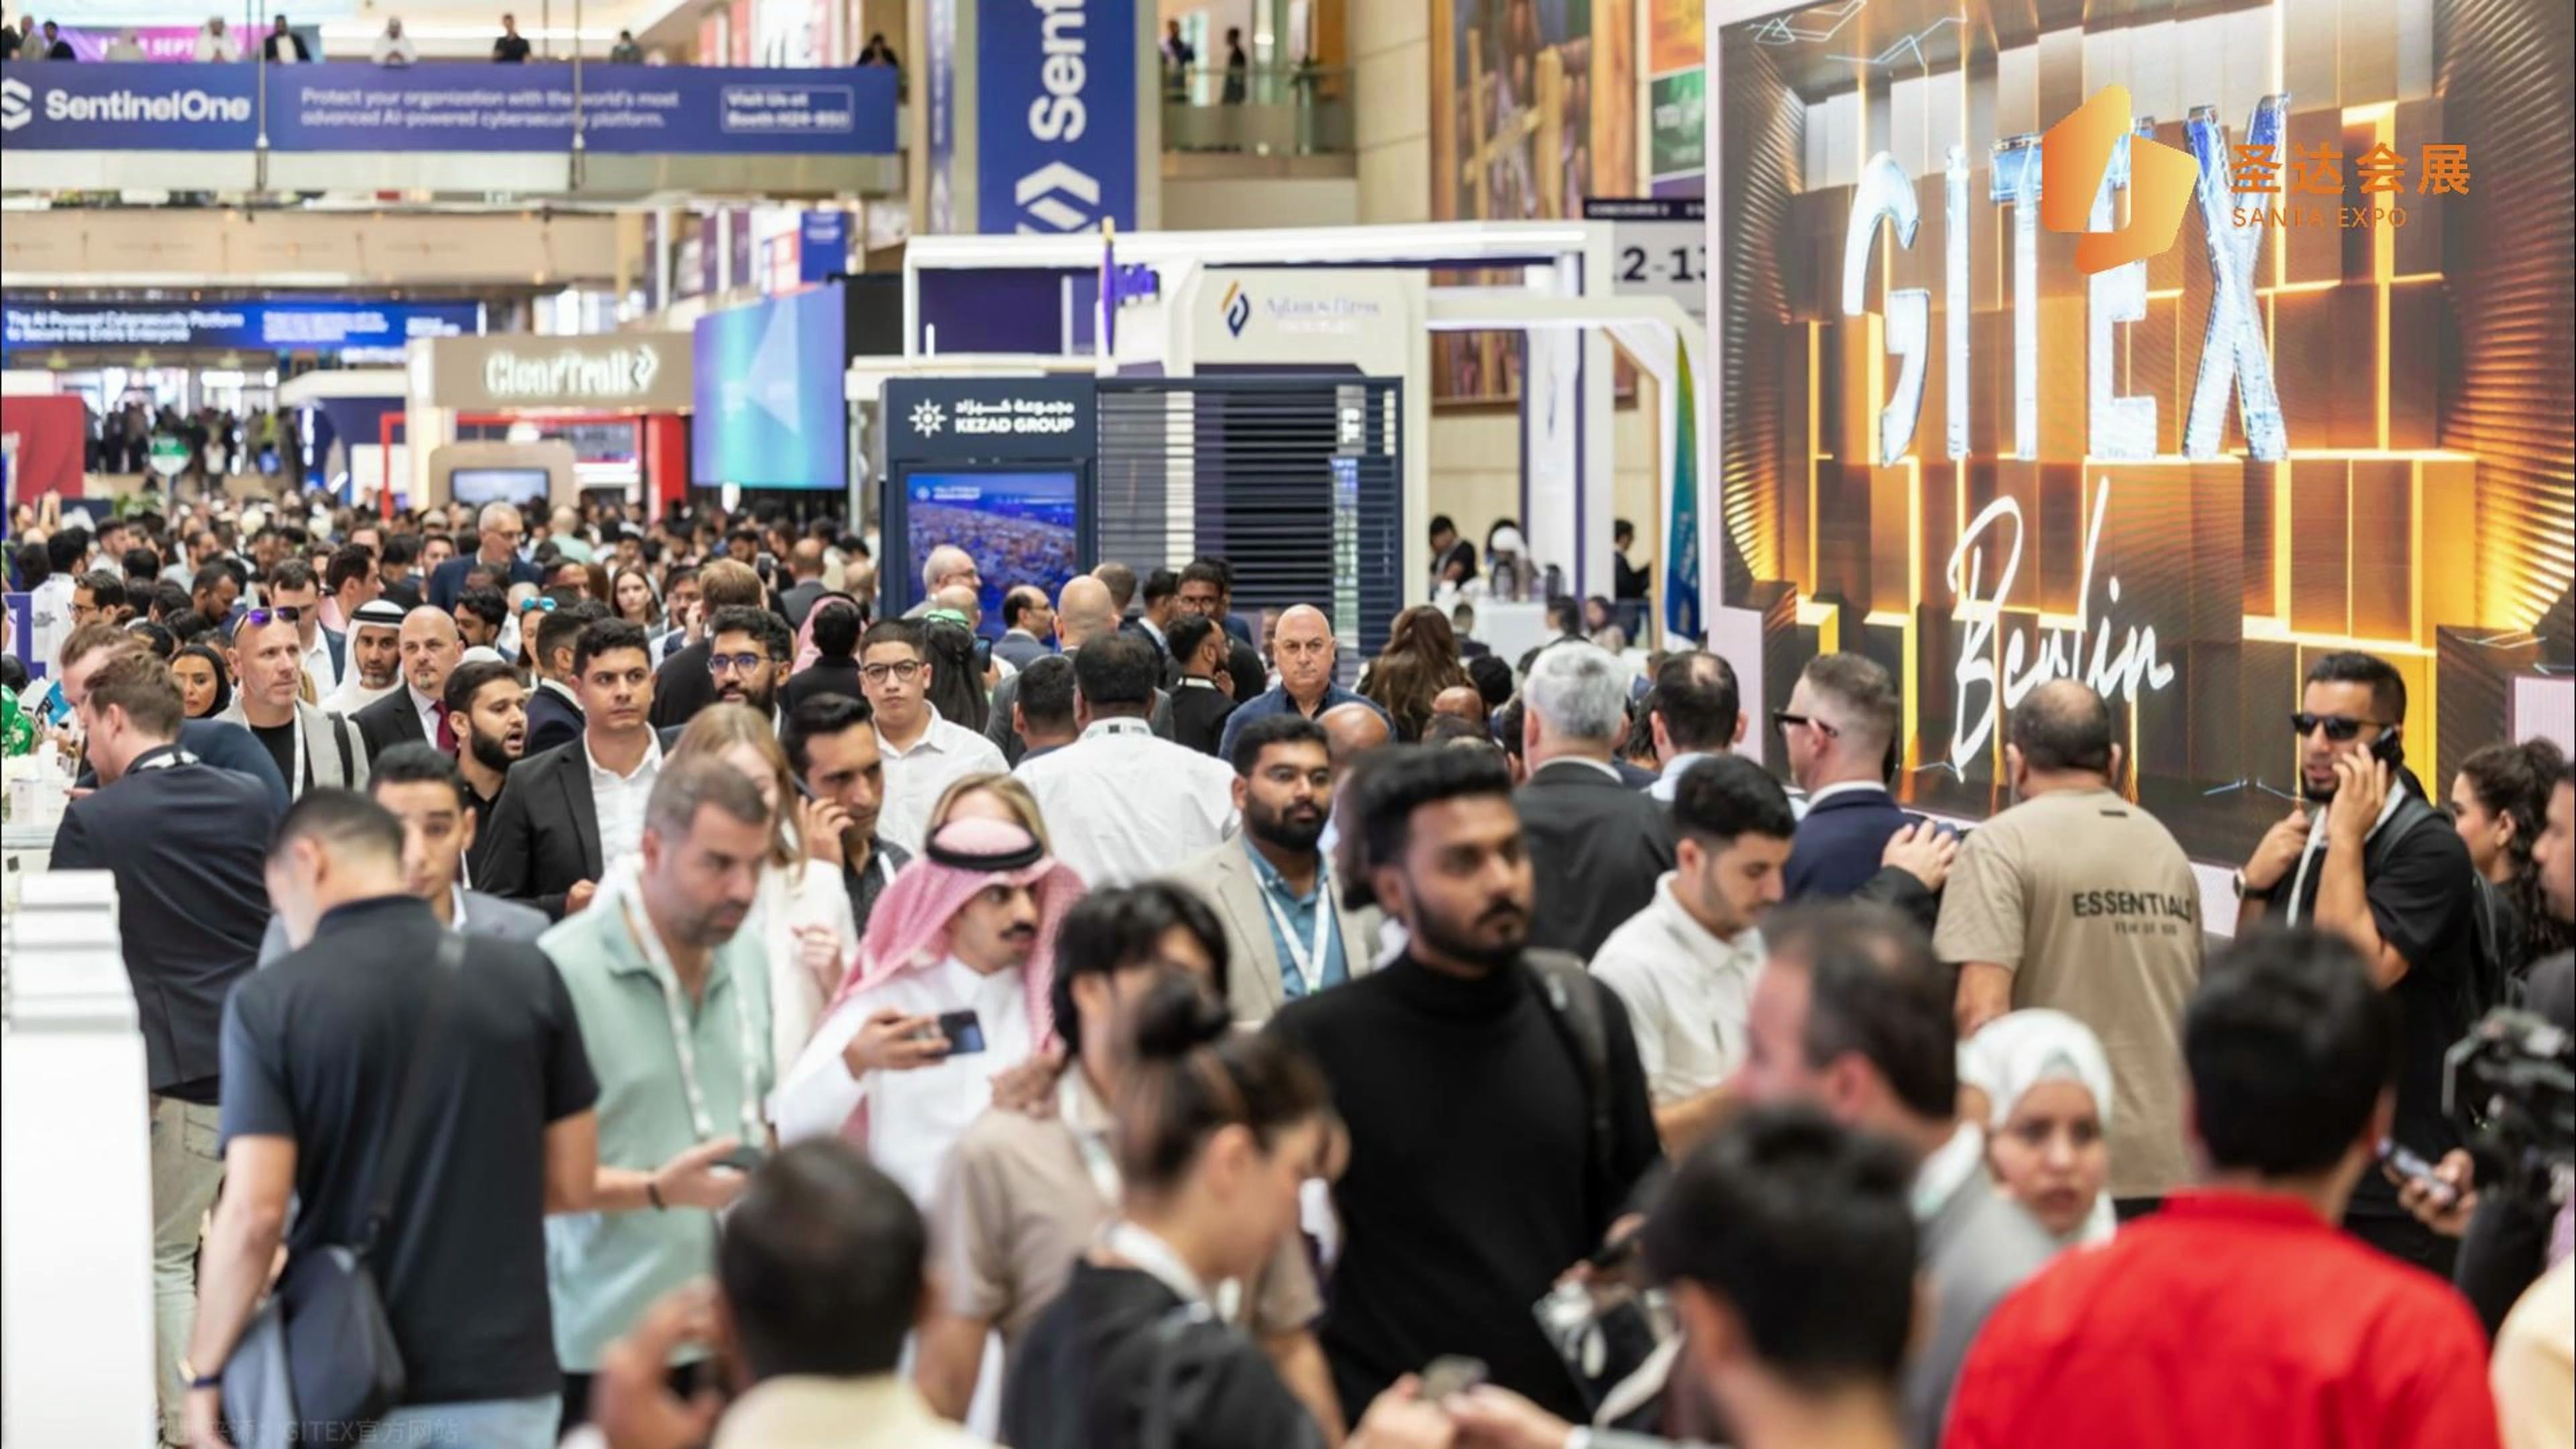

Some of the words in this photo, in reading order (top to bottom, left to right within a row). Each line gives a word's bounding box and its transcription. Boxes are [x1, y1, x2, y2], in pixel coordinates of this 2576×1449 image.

[45, 89, 252, 121] SentinelOne
[301, 87, 361, 106] Protect
[365, 91, 400, 109] your
[404, 89, 503, 110] organization
[508, 91, 542, 107] with
[547, 91, 573, 107] the
[637, 91, 680, 108] most
[301, 109, 380, 125] advanced
[382, 109, 478, 127] AI-powered
[1842, 93, 2292, 466] GITEX
[486, 348, 629, 394] ClearTrail
[955, 417, 1012, 433] KEZAD
[1014, 417, 1075, 433] GROUP
[1947, 475, 2174, 784] Berlin
